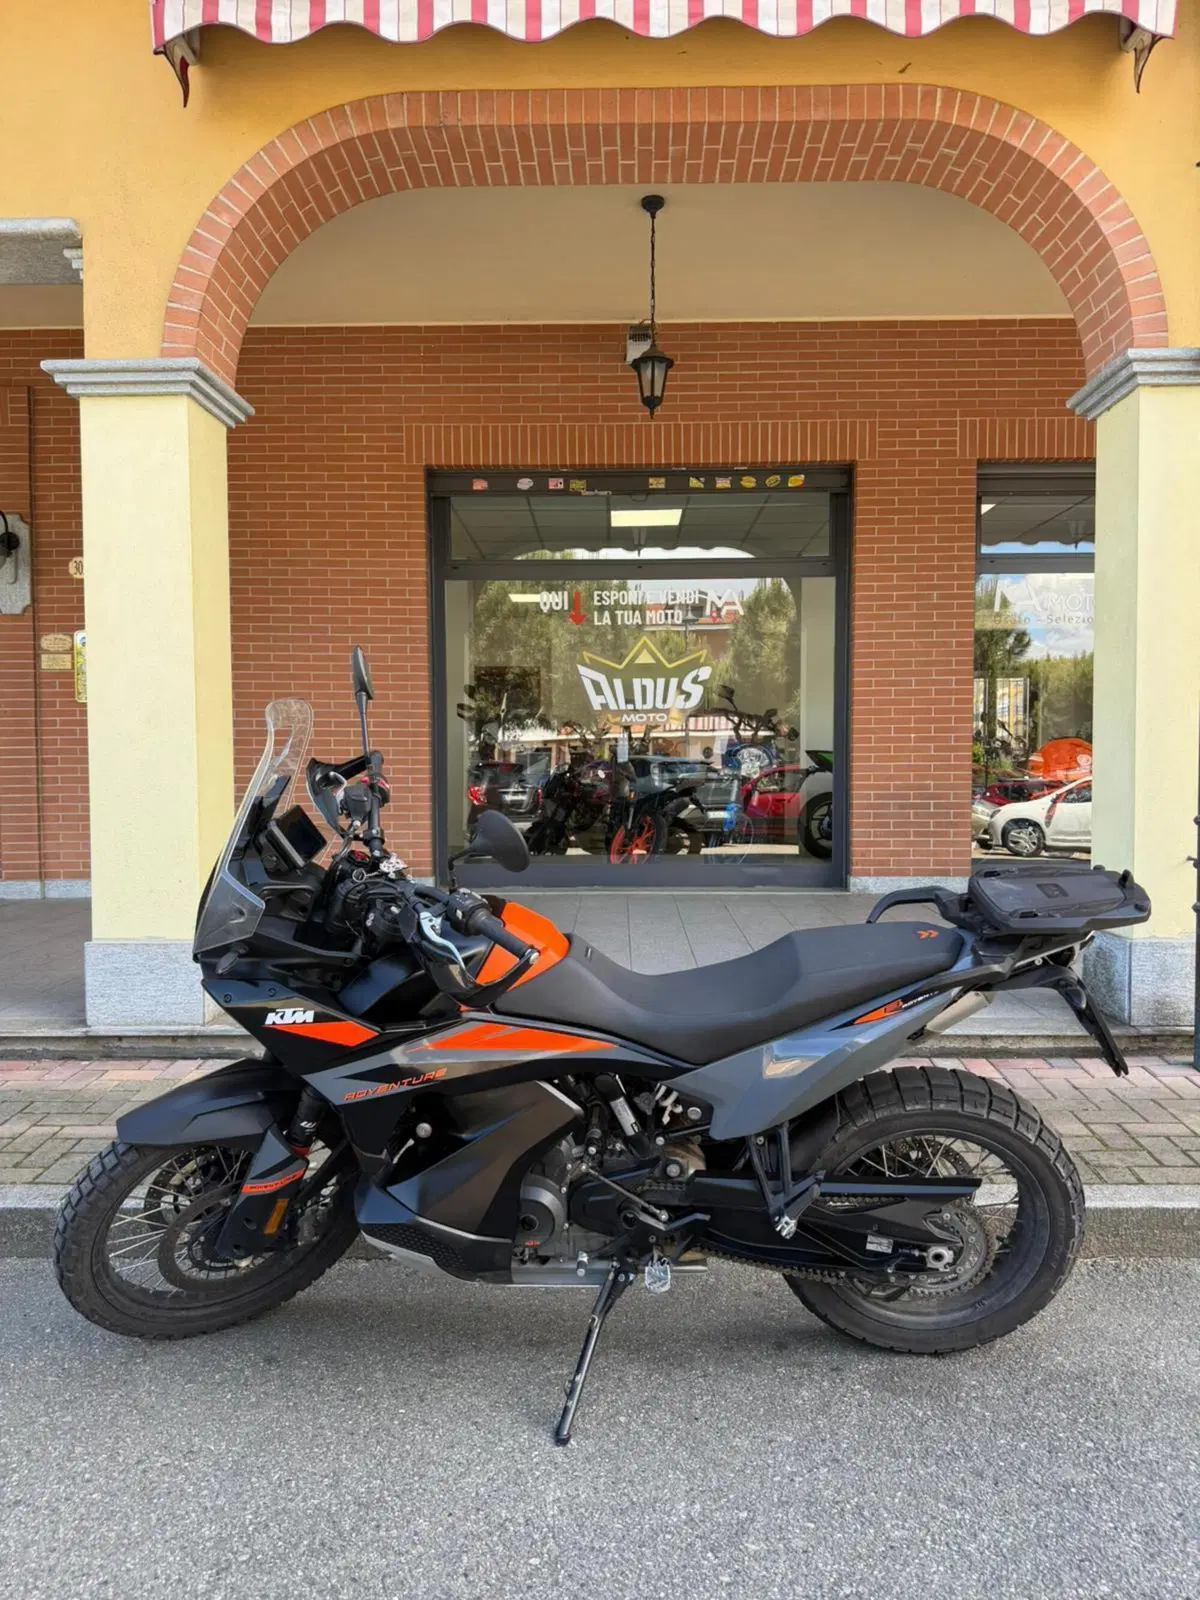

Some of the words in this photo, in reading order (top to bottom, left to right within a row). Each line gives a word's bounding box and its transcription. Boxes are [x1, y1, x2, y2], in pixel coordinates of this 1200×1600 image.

[539, 591, 569, 613] QUI
[593, 590, 641, 606] ESPONI
[660, 590, 700, 605] VENDI
[593, 610, 612, 626] LA
[615, 610, 642, 626] TUA
[646, 610, 683, 625] MOTO
[576, 663, 713, 711] ALDUS
[622, 713, 668, 723] MOTO
[265, 1007, 315, 1025] KTM
[344, 1067, 448, 1101] ADVENTURE
